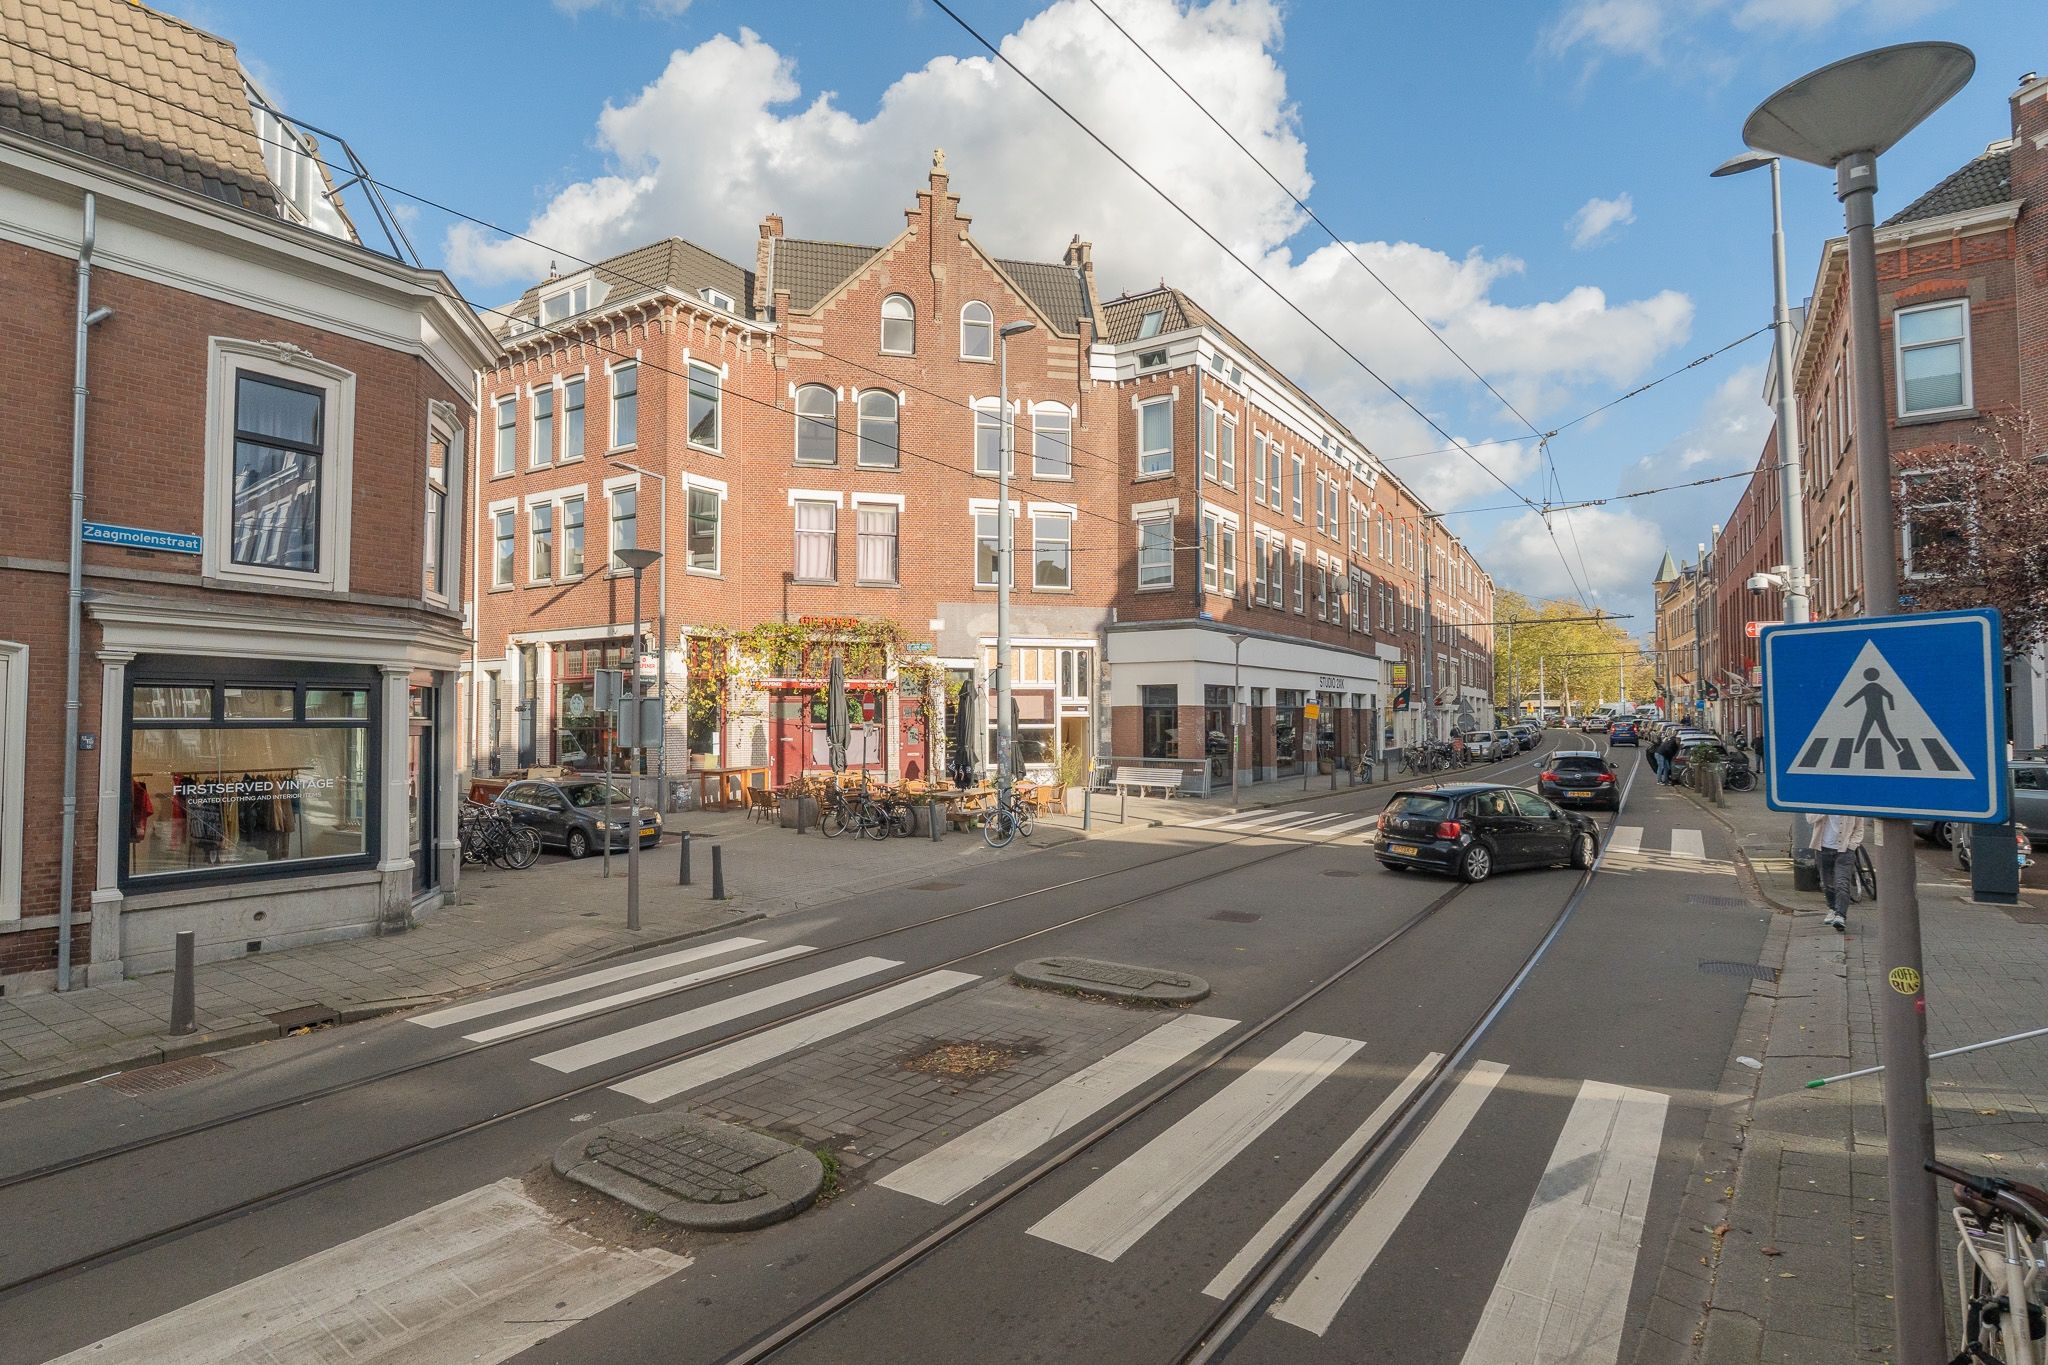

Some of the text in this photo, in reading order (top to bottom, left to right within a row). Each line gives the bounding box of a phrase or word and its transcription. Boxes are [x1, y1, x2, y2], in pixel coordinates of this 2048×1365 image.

[83, 525, 198, 549] Zaagmolenstraat
[1319, 676, 1336, 689] STUDIO
[172, 778, 334, 796] FIRSTSERVED VINTAGE
[187, 791, 322, 805] CURATED CLOTHING AND INTERIOR ITEMS
